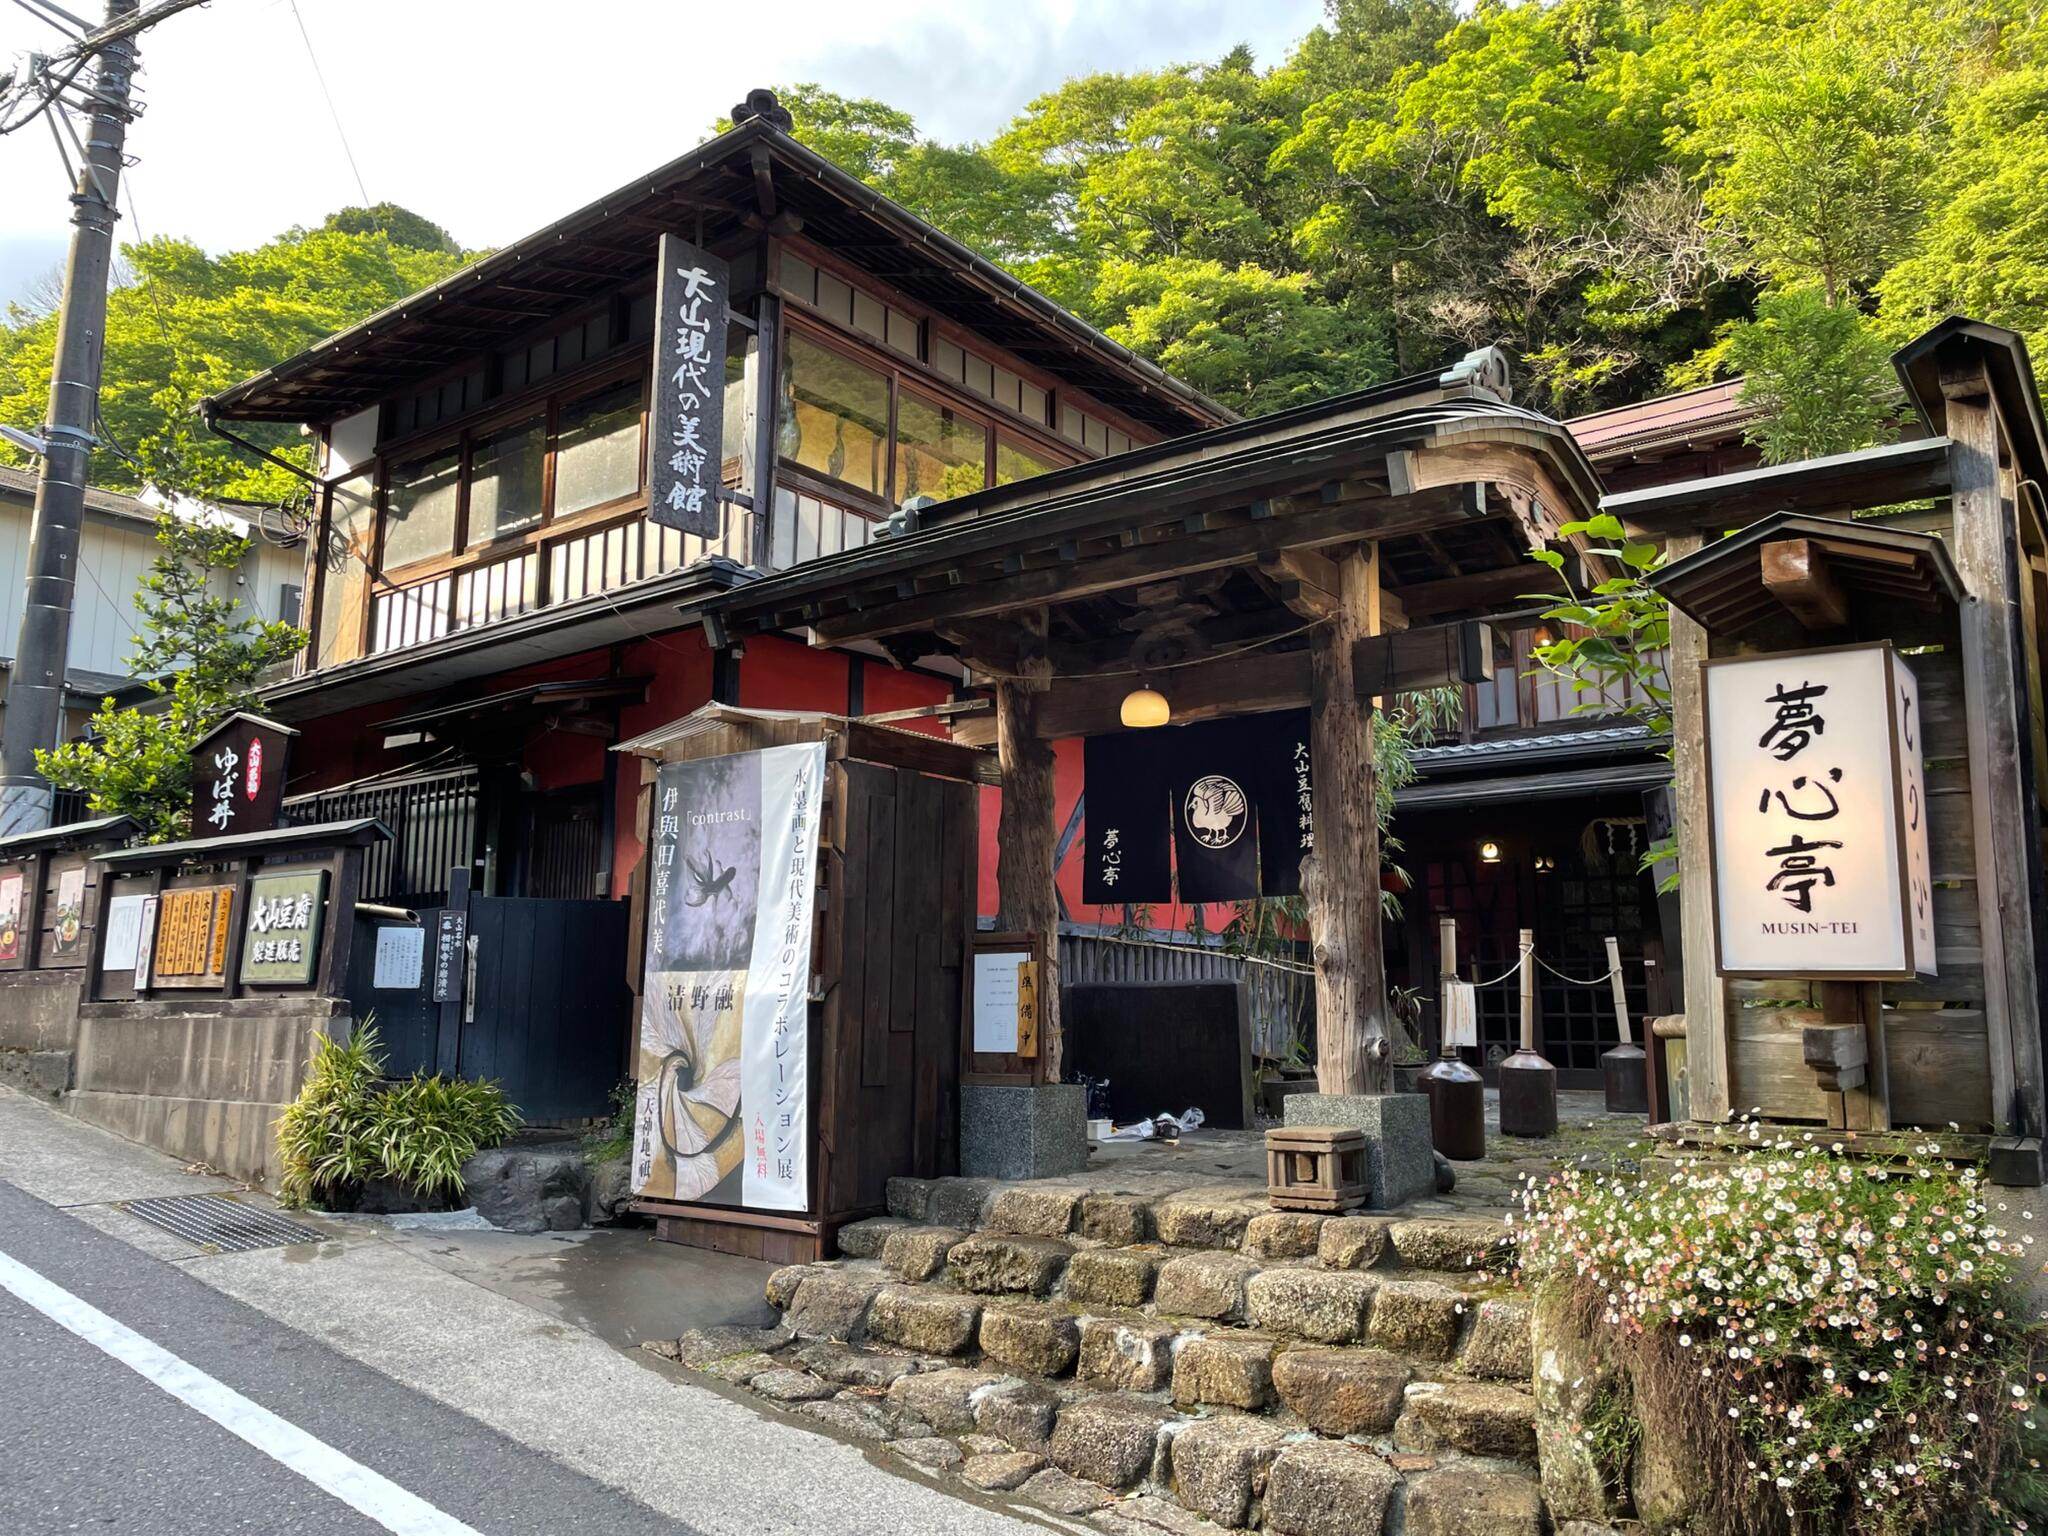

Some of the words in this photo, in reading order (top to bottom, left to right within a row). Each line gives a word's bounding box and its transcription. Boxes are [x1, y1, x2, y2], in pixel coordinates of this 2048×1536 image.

[664, 266, 717, 514] 大山現代の美術館
[208, 746, 239, 831] ゆば丼
[1293, 742, 1315, 849] 大山豆腐料理
[1758, 680, 1844, 913] 夢心亭
[1102, 828, 1122, 886] 夢心亭
[250, 893, 313, 933] 大山豆腐
[1761, 922, 1858, 935] MUSIN-TEI
[774, 768, 807, 1180] 水墨画と現代美術のコラボレーション展
[753, 1112, 768, 1179] 入場無料
